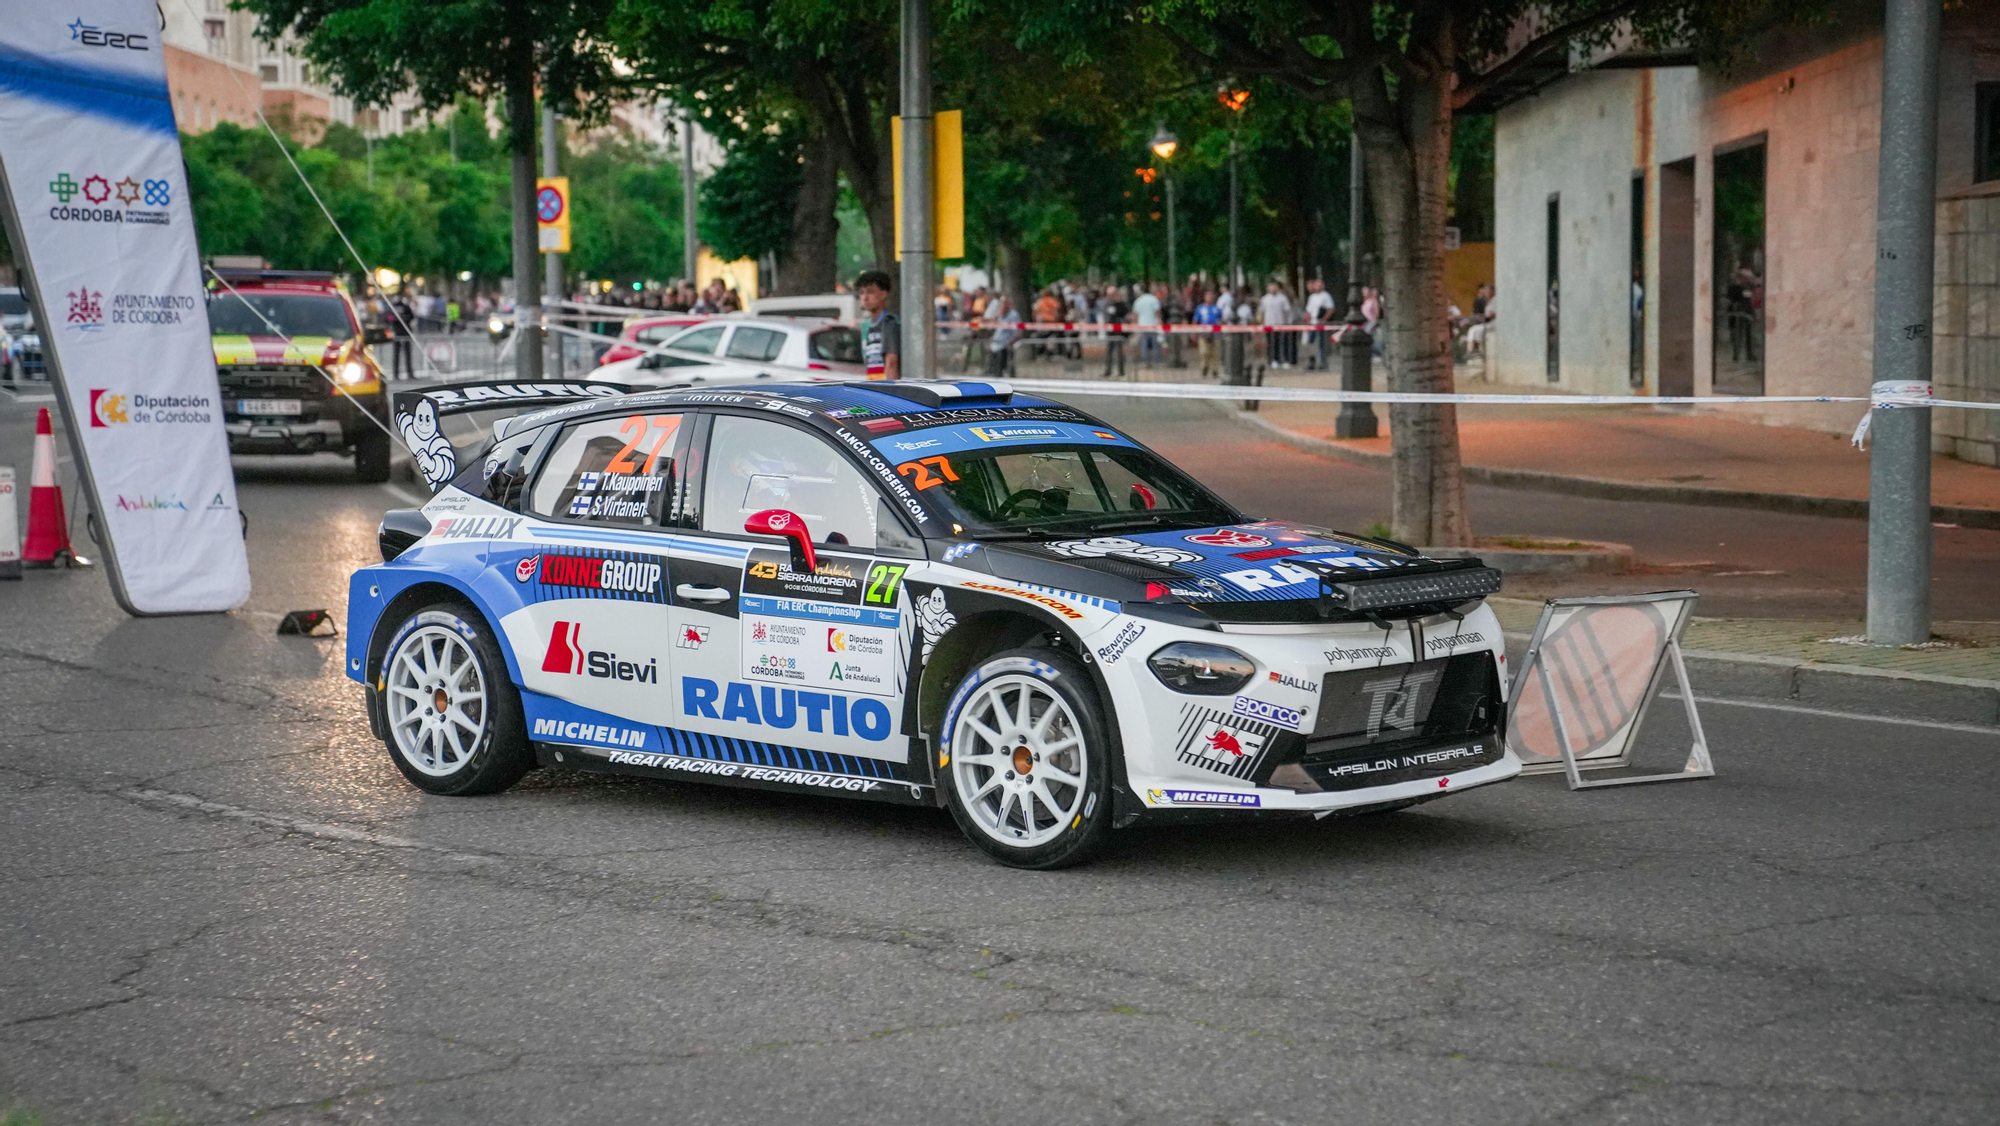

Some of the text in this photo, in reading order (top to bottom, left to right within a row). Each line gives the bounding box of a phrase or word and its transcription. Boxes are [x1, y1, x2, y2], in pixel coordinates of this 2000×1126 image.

[81, 30, 148, 50] ERC
[50, 205, 123, 223] CÓRDOBA
[113, 295, 195, 310] AYUNTAMIENTO
[112, 309, 181, 324] DE CÓRDOBA
[134, 395, 209, 410] Diputación
[423, 383, 627, 404] RAUTIO
[134, 410, 210, 423] de Córdoba
[1002, 428, 1057, 437] MICHELIN
[605, 415, 683, 474] 27
[905, 439, 942, 450] ERC
[835, 427, 928, 524] LANCIA-CORSEHF.COM
[897, 455, 960, 491] 27
[602, 473, 664, 496] T.Kauppinen
[442, 518, 523, 539] HALLIX
[749, 561, 778, 579] 43
[777, 572, 857, 588] SIERRA MORENA
[801, 584, 827, 593] CÓRDOBA
[865, 564, 906, 604] 27
[1170, 588, 1213, 598] Sievi
[776, 600, 861, 619] FIA ERC Championship
[770, 624, 806, 636] AYUNTAMIENTO
[769, 634, 800, 645] DE CÓRDOBA
[849, 634, 883, 645] Diputación
[1426, 631, 1485, 654] pohjanmaan
[858, 644, 883, 655] Córdoba
[1323, 645, 1397, 665] pohjanmaan
[588, 651, 657, 684] Sievi
[751, 665, 784, 678] CÓRDOBA
[845, 664, 861, 672] Junta
[853, 673, 881, 683] Andalucía
[1278, 674, 1318, 693] HALLIX
[682, 676, 892, 742] RAUTIO
[1235, 697, 1301, 724] sparco
[534, 718, 646, 748] MICHELIN
[1328, 745, 1484, 776] YPSILON INTEGRALE
[608, 751, 882, 794] TAGAI RACING TECHNOLOGY
[1173, 792, 1257, 804] MICHELIN
